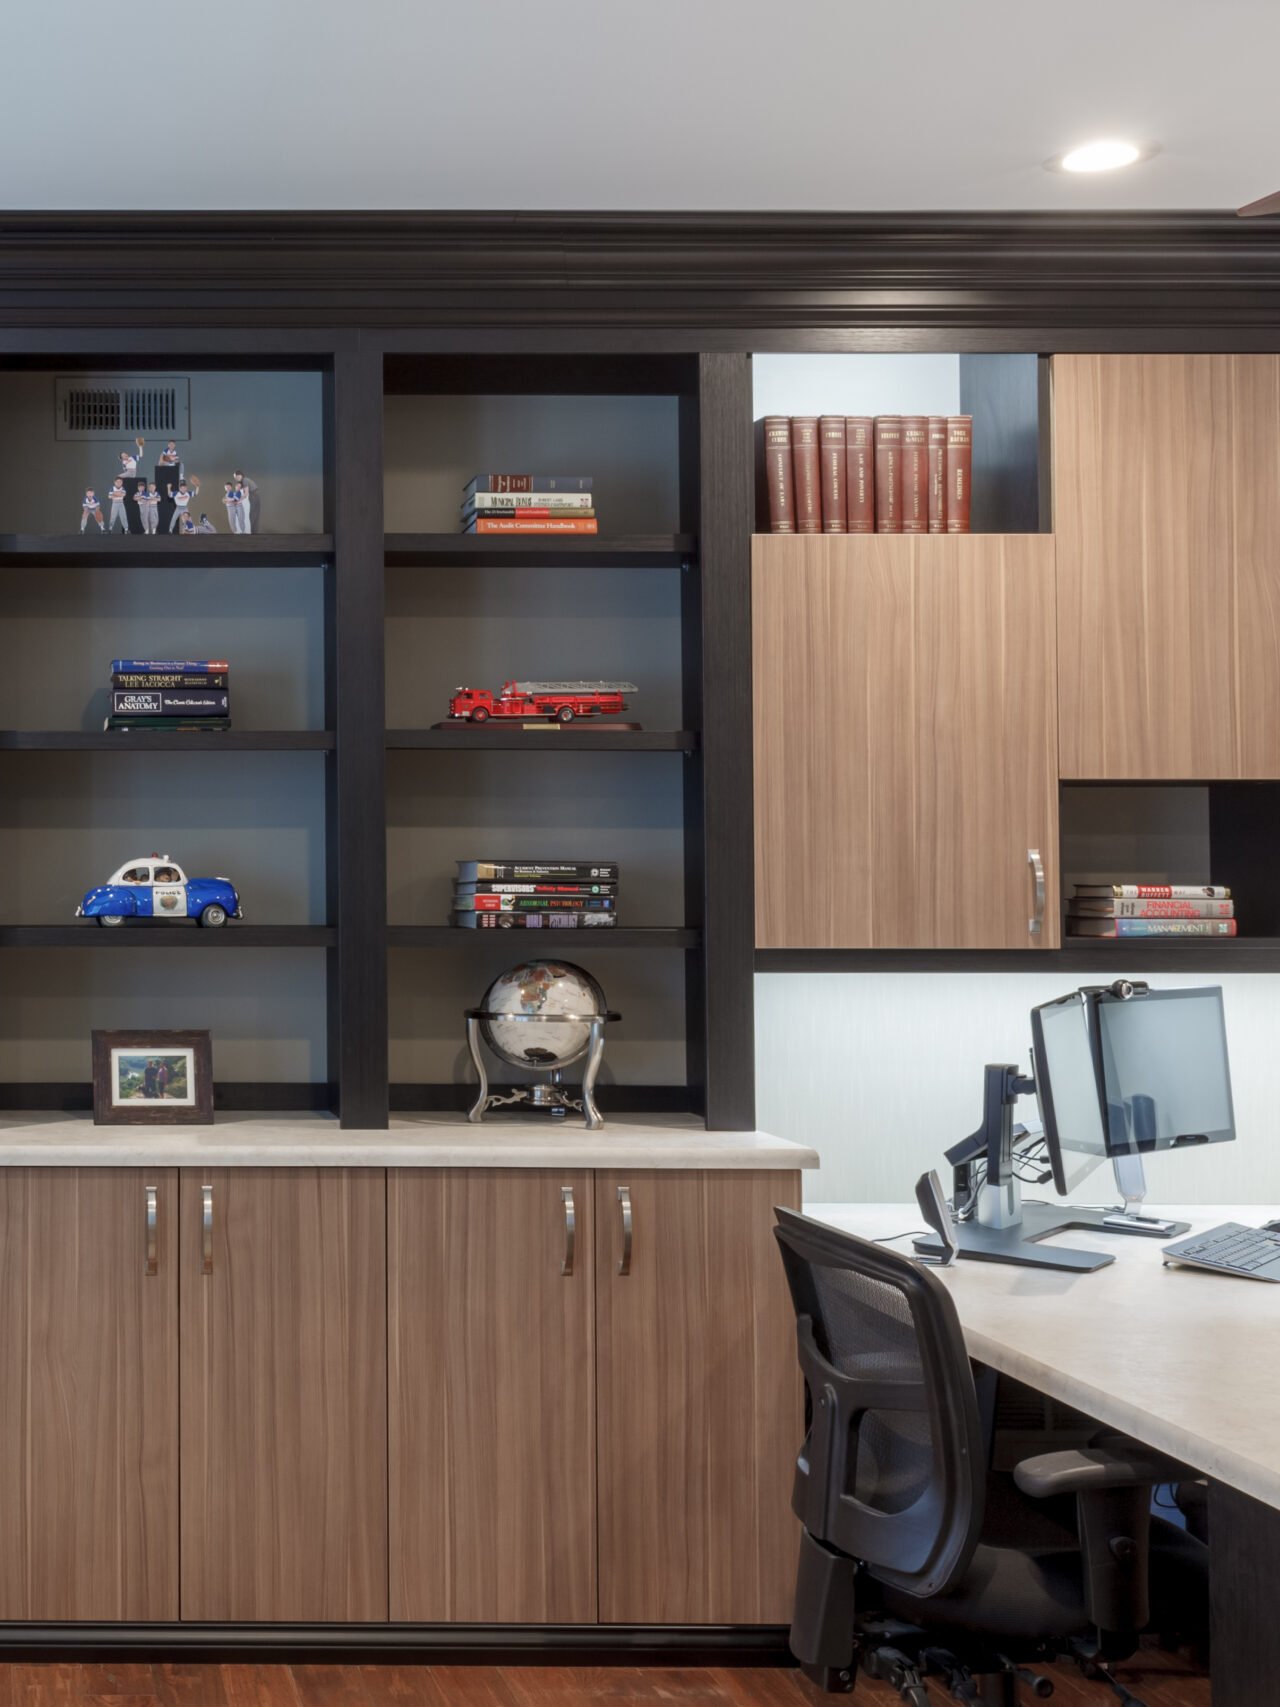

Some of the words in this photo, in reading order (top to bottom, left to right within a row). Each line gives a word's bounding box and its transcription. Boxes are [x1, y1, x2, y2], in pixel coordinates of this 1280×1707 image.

[124, 695, 152, 703] GRAY'S
[118, 702, 158, 710] ANATOMY
[1146, 901, 1193, 909] FINANCIAL
[1140, 909, 1200, 918] ACCOUNTING
[1147, 925, 1204, 933] MANAGEMENT
